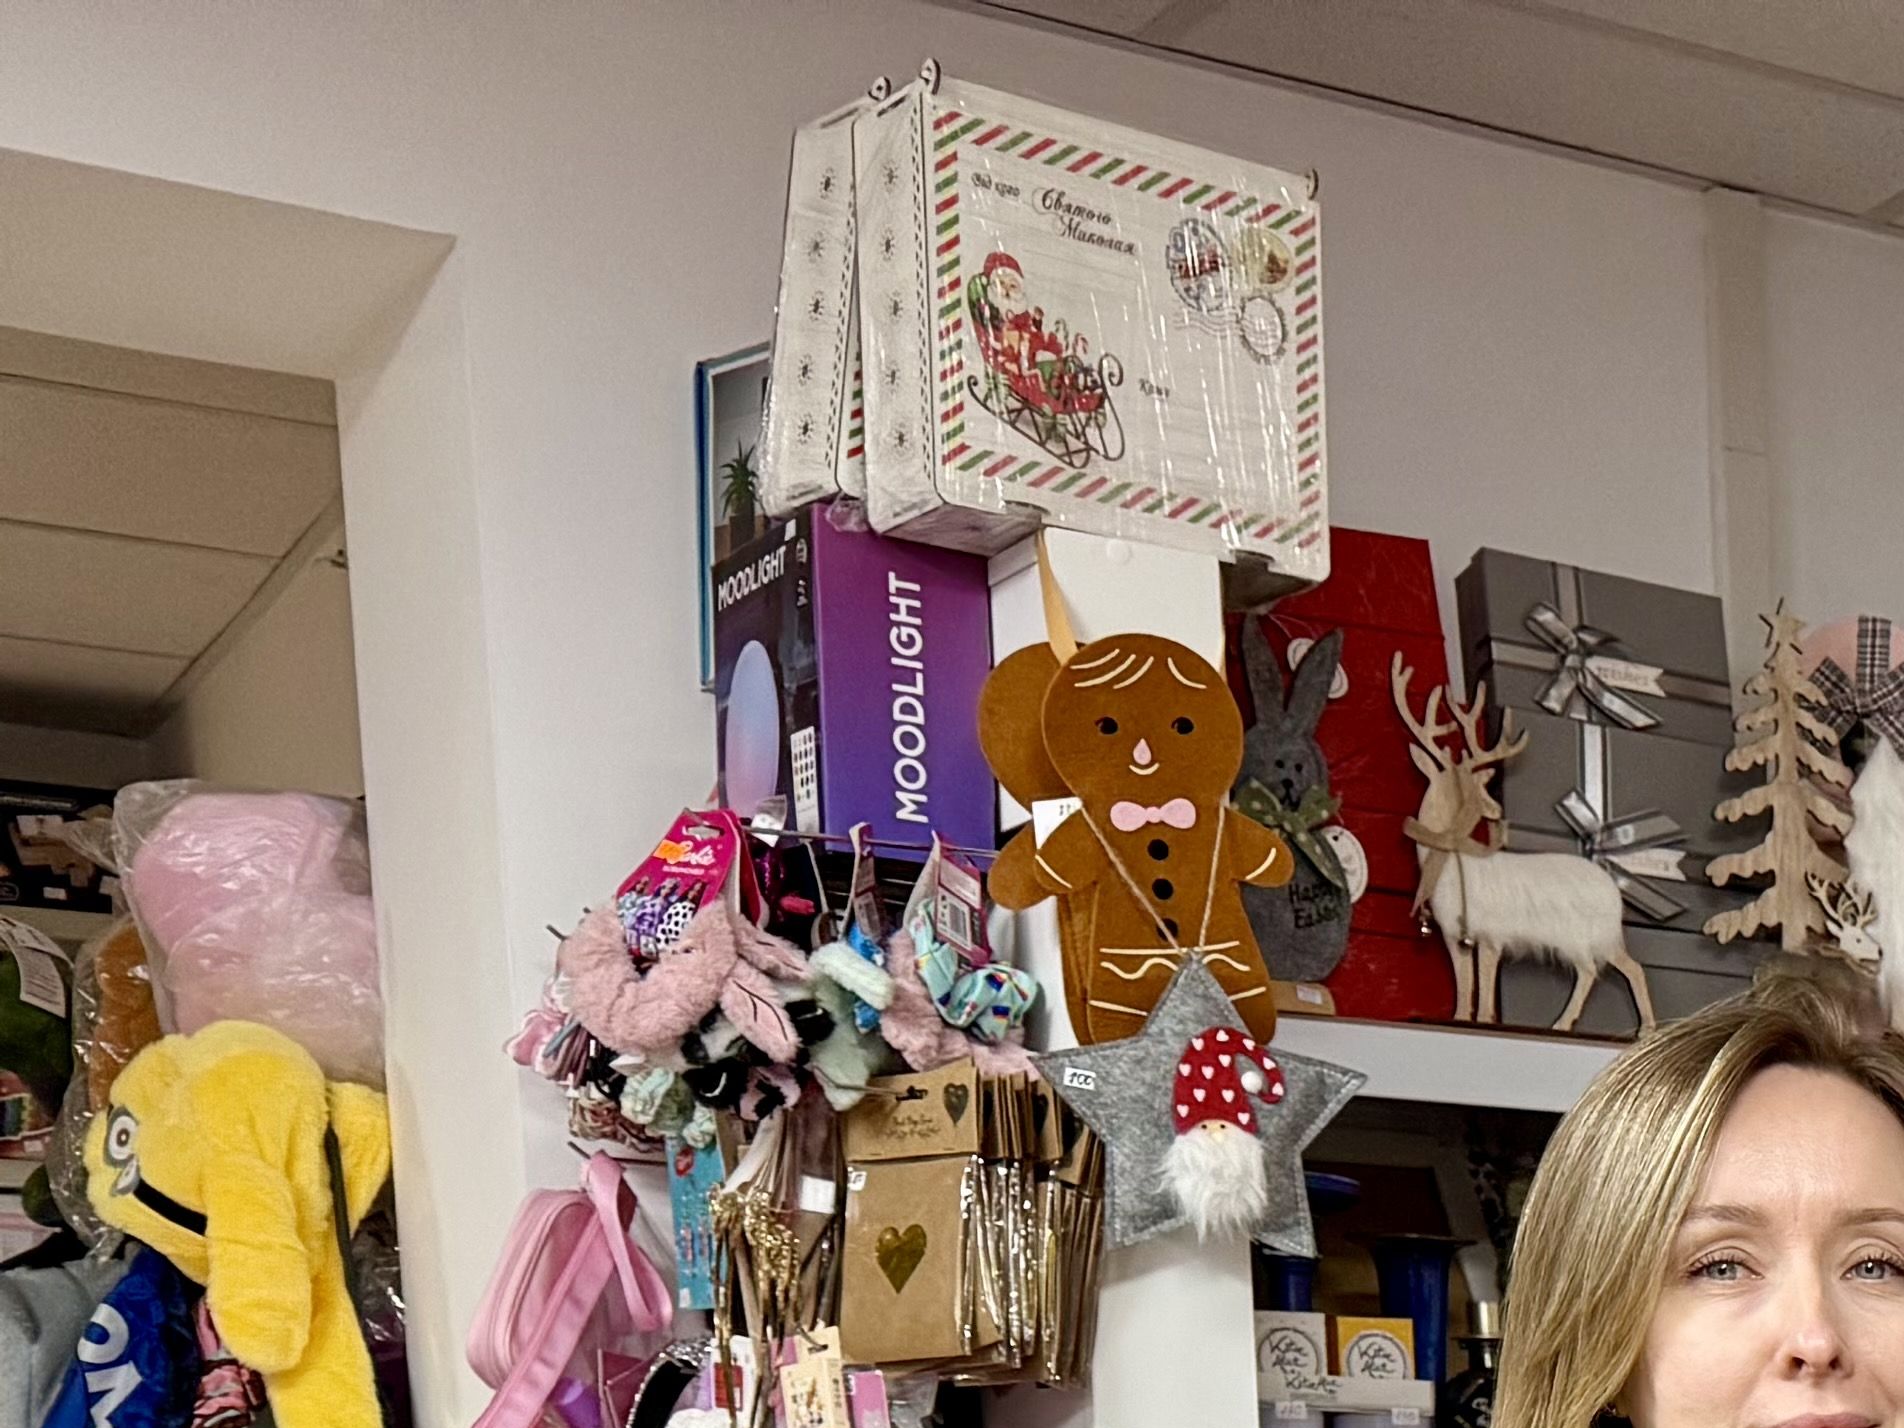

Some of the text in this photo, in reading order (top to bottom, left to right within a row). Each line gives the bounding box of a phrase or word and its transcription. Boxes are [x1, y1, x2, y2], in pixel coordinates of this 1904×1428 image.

[1032, 187, 1112, 225] Святого
[1056, 215, 1139, 256] Миколая
[717, 545, 787, 613] MOODLIGHT
[887, 570, 930, 825] MOODLIGHT
